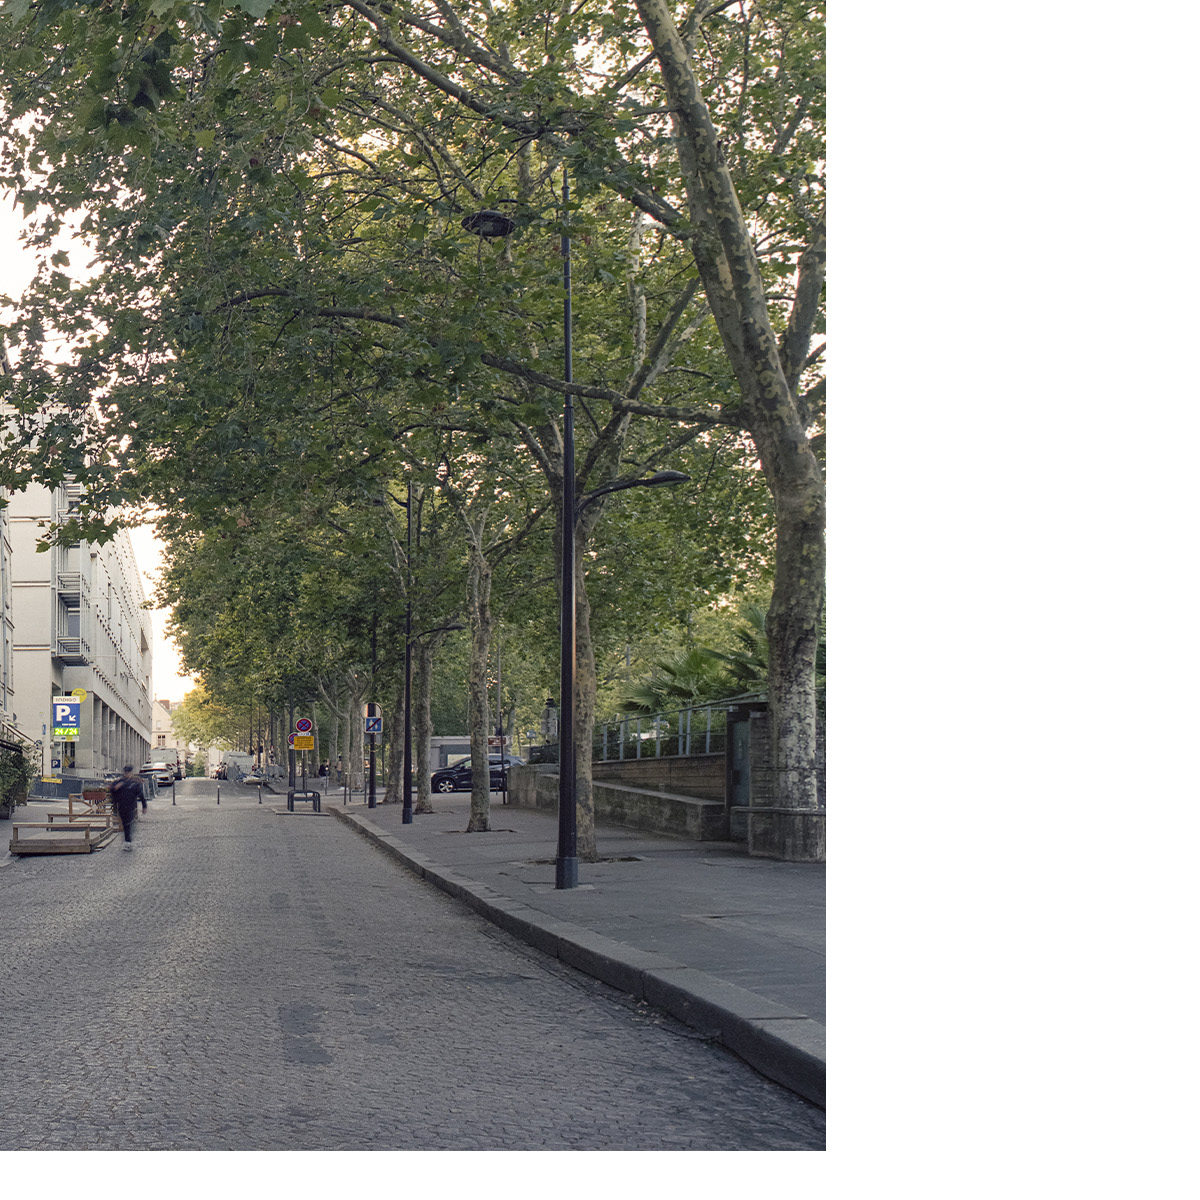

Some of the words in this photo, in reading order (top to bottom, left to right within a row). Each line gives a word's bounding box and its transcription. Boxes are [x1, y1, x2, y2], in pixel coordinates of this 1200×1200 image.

[56, 704, 71, 721] P
[54, 728, 78, 736] 24/24
[52, 760, 59, 768] P
